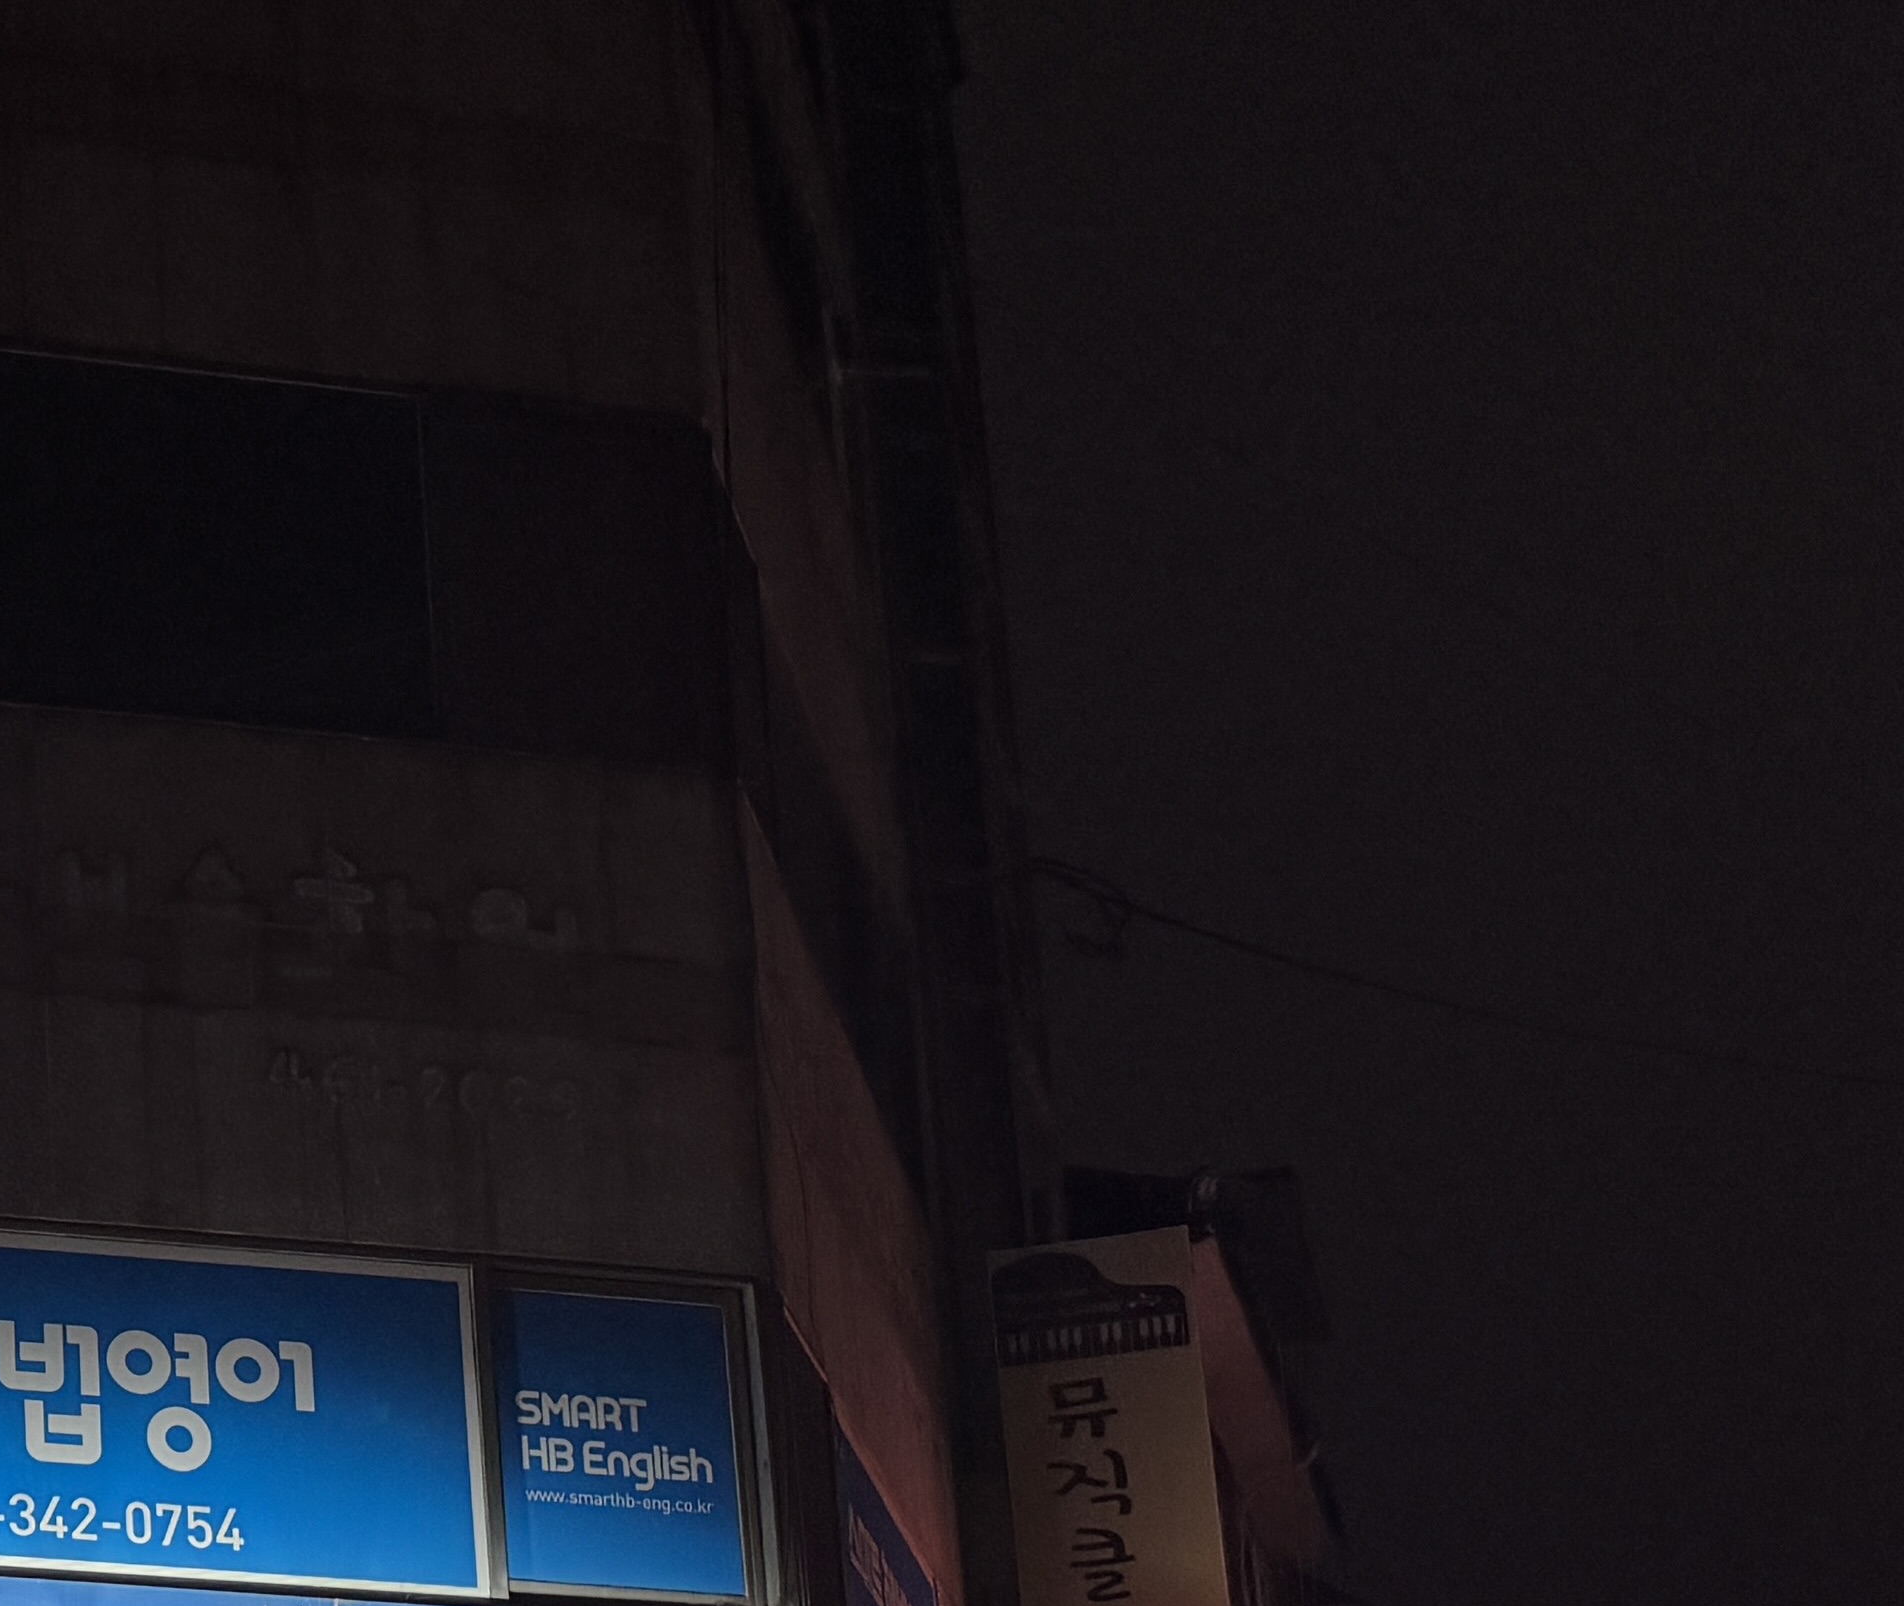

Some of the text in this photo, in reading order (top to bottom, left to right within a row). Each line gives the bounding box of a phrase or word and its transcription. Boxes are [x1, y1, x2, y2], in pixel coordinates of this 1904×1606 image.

[515, 1389, 647, 1433] SMART
[522, 1435, 714, 1492] HB English
